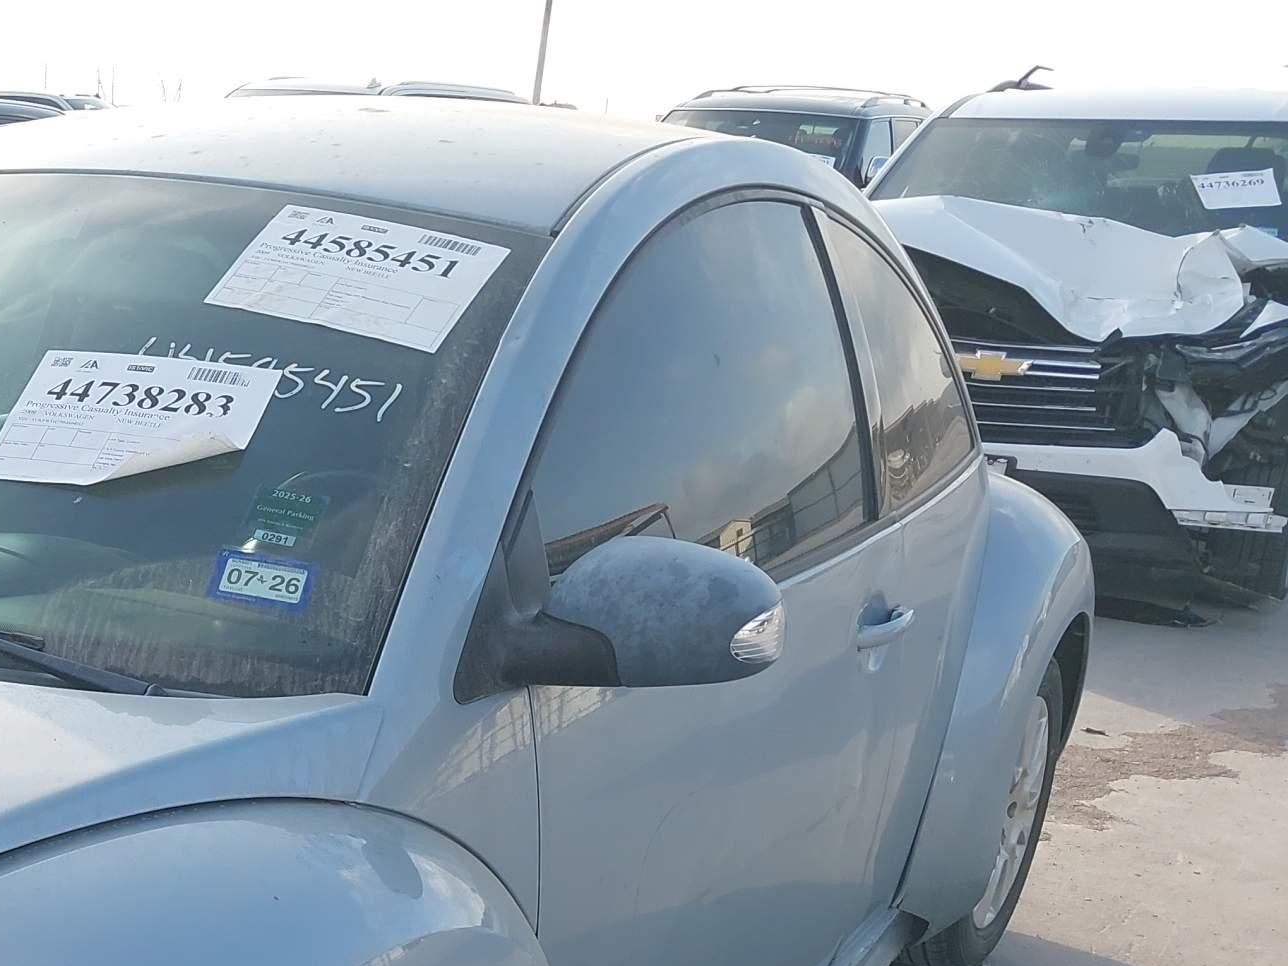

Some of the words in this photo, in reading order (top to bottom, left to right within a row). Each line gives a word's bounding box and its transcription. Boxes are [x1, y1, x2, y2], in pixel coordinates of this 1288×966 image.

[1198, 178, 1265, 190] 44736269
[260, 242, 312, 256] Progressive
[313, 251, 352, 264] Casualty
[352, 259, 399, 275] Insurance
[281, 229, 460, 279] 44585451
[47, 378, 234, 418] 44738283
[26, 400, 79, 412] Progressive
[80, 403, 122, 416] Casualty
[124, 408, 171, 421] Insurance
[44, 411, 95, 420] VOLKSWAGEN
[272, 489, 312, 503] 2025-26
[256, 504, 286, 515] General
[286, 510, 315, 521] Parking
[261, 532, 289, 545] 0291
[226, 568, 259, 588] 07
[268, 574, 301, 595] 26
